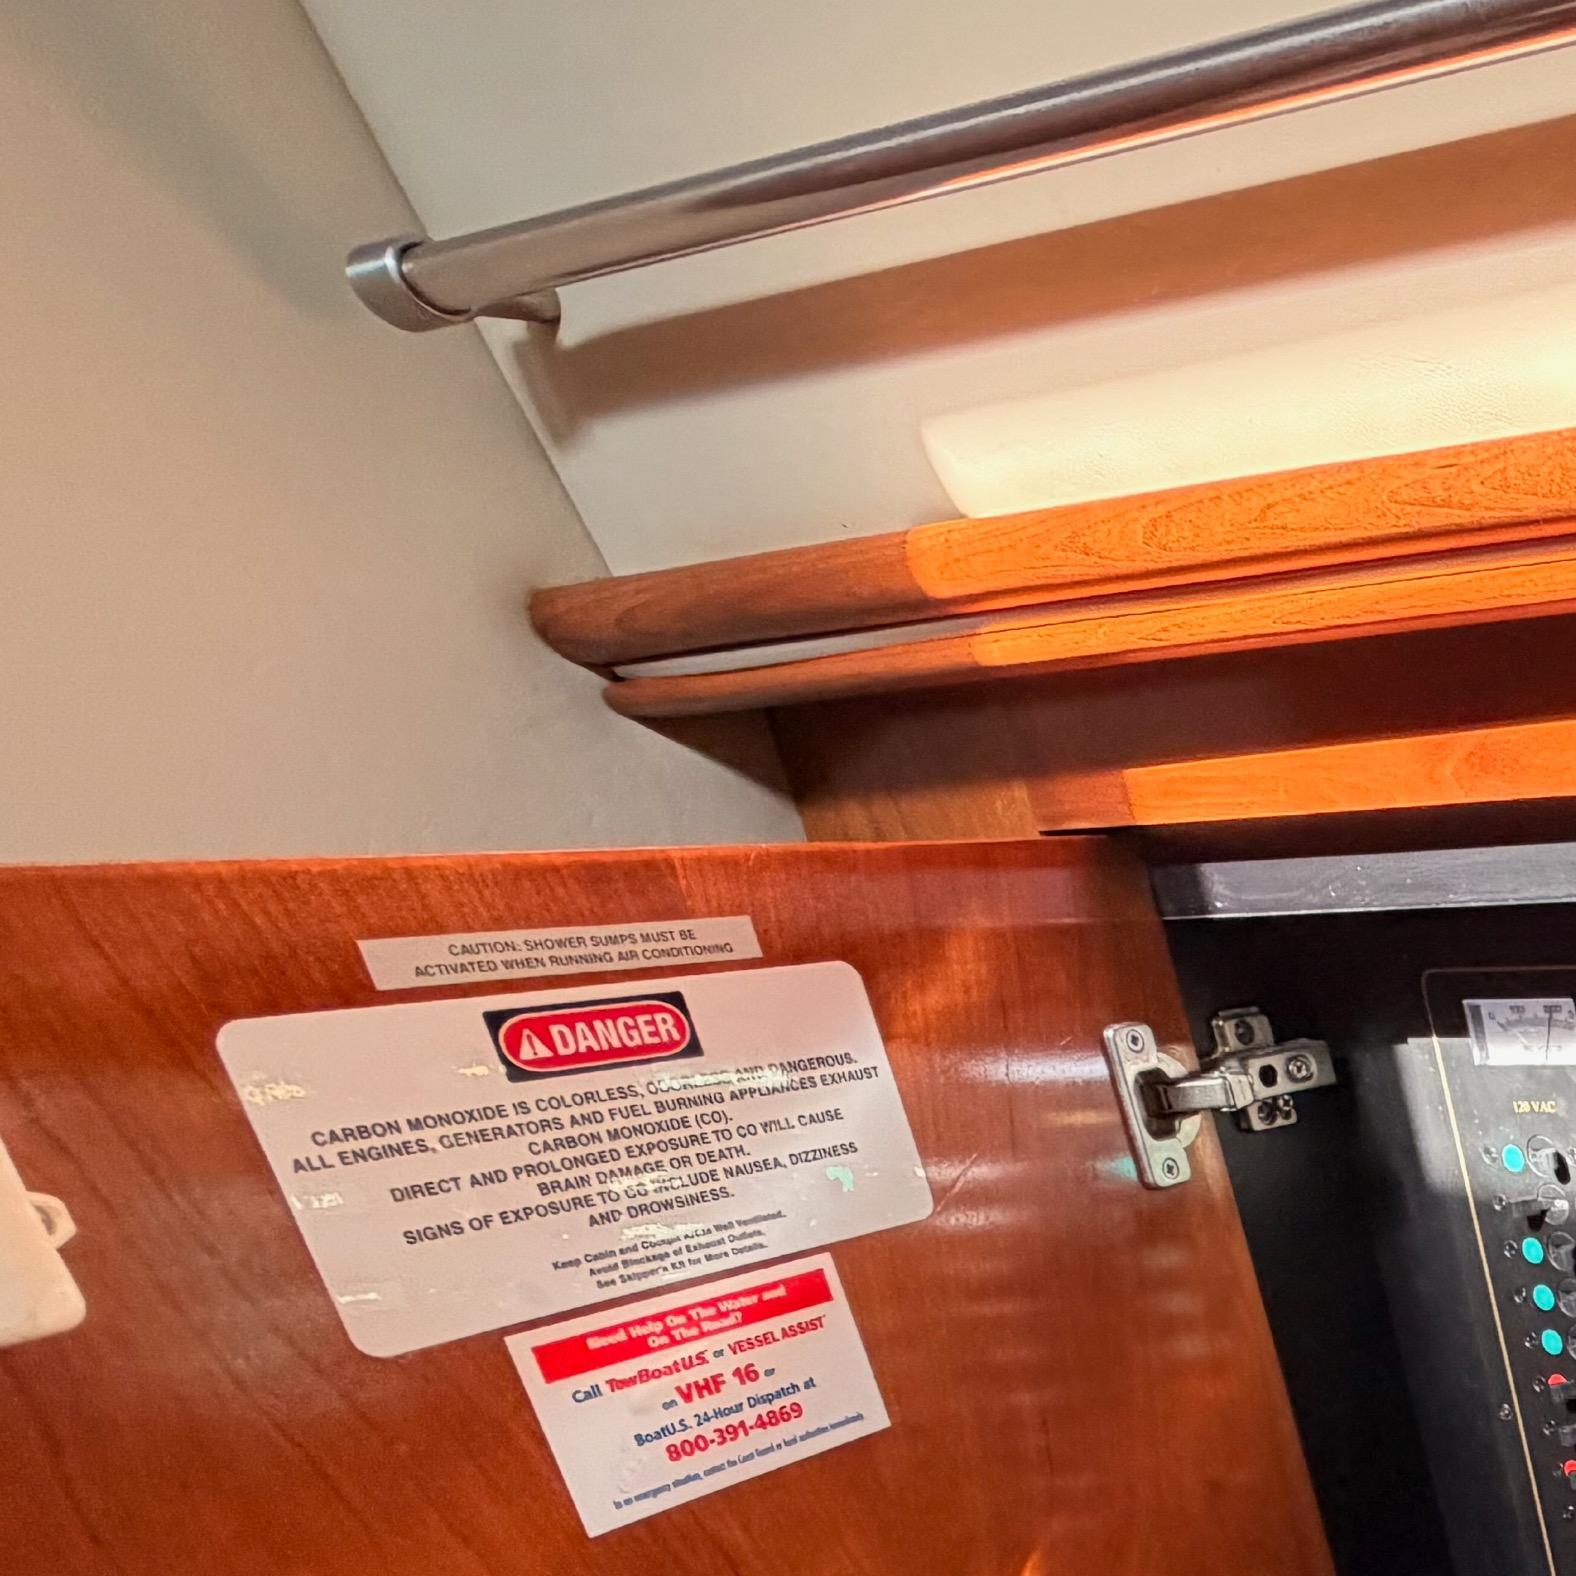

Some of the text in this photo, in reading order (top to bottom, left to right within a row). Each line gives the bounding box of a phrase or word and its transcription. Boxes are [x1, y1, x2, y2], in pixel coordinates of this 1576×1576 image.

[414, 942, 734, 977] ACTIVATED WHEN RUNNING AIR CONDITIONING
[447, 928, 697, 957] CAUTION: SHOWER SUMPS MUST BE
[550, 1013, 682, 1056] DANGER
[293, 1154, 336, 1173] ALL
[336, 1138, 437, 1166] ENGINES,
[438, 1116, 565, 1149] GENERATORS
[569, 1110, 604, 1128] AND
[607, 1103, 652, 1121] FUEL
[653, 1091, 725, 1114] BURNING
[729, 1075, 818, 1101] APPLIANCES
[819, 1065, 879, 1086] EXHAUST
[310, 1119, 402, 1147] CARBON
[405, 1104, 509, 1131] MONOXIDE
[511, 1100, 531, 1116] IS
[535, 1084, 645, 1112] COLORLESS,
[766, 1051, 858, 1076] DANGEROUS.
[389, 1107, 844, 1202] DIRECT AND PROLONGED EXPOSURE TO CO WILL CAUSE
[527, 1109, 733, 1155] CARBON MONOXIDE (CO).
[402, 1220, 464, 1245] SIGNS
[468, 1214, 493, 1231] OF
[498, 1193, 597, 1225] EXPOSURE
[595, 1189, 621, 1204] TO
[722, 1156, 787, 1179] NAUSEA,
[788, 1141, 858, 1166] DIZZINESS
[536, 1144, 751, 1196] BRAIN DAMAGE OR DEATH.
[589, 1186, 735, 1227] AND DROWSINESS.
[571, 1383, 603, 1403] Call
[712, 1348, 724, 1358] or
[727, 1330, 780, 1355] VESSEL
[780, 1315, 824, 1340] ASSIST
[633, 1376, 816, 1447] BoatU.S. 24-Hour Dispatch at
[662, 1365, 775, 1410] on VHF 16 or
[665, 1401, 803, 1462] 800-391-4869
